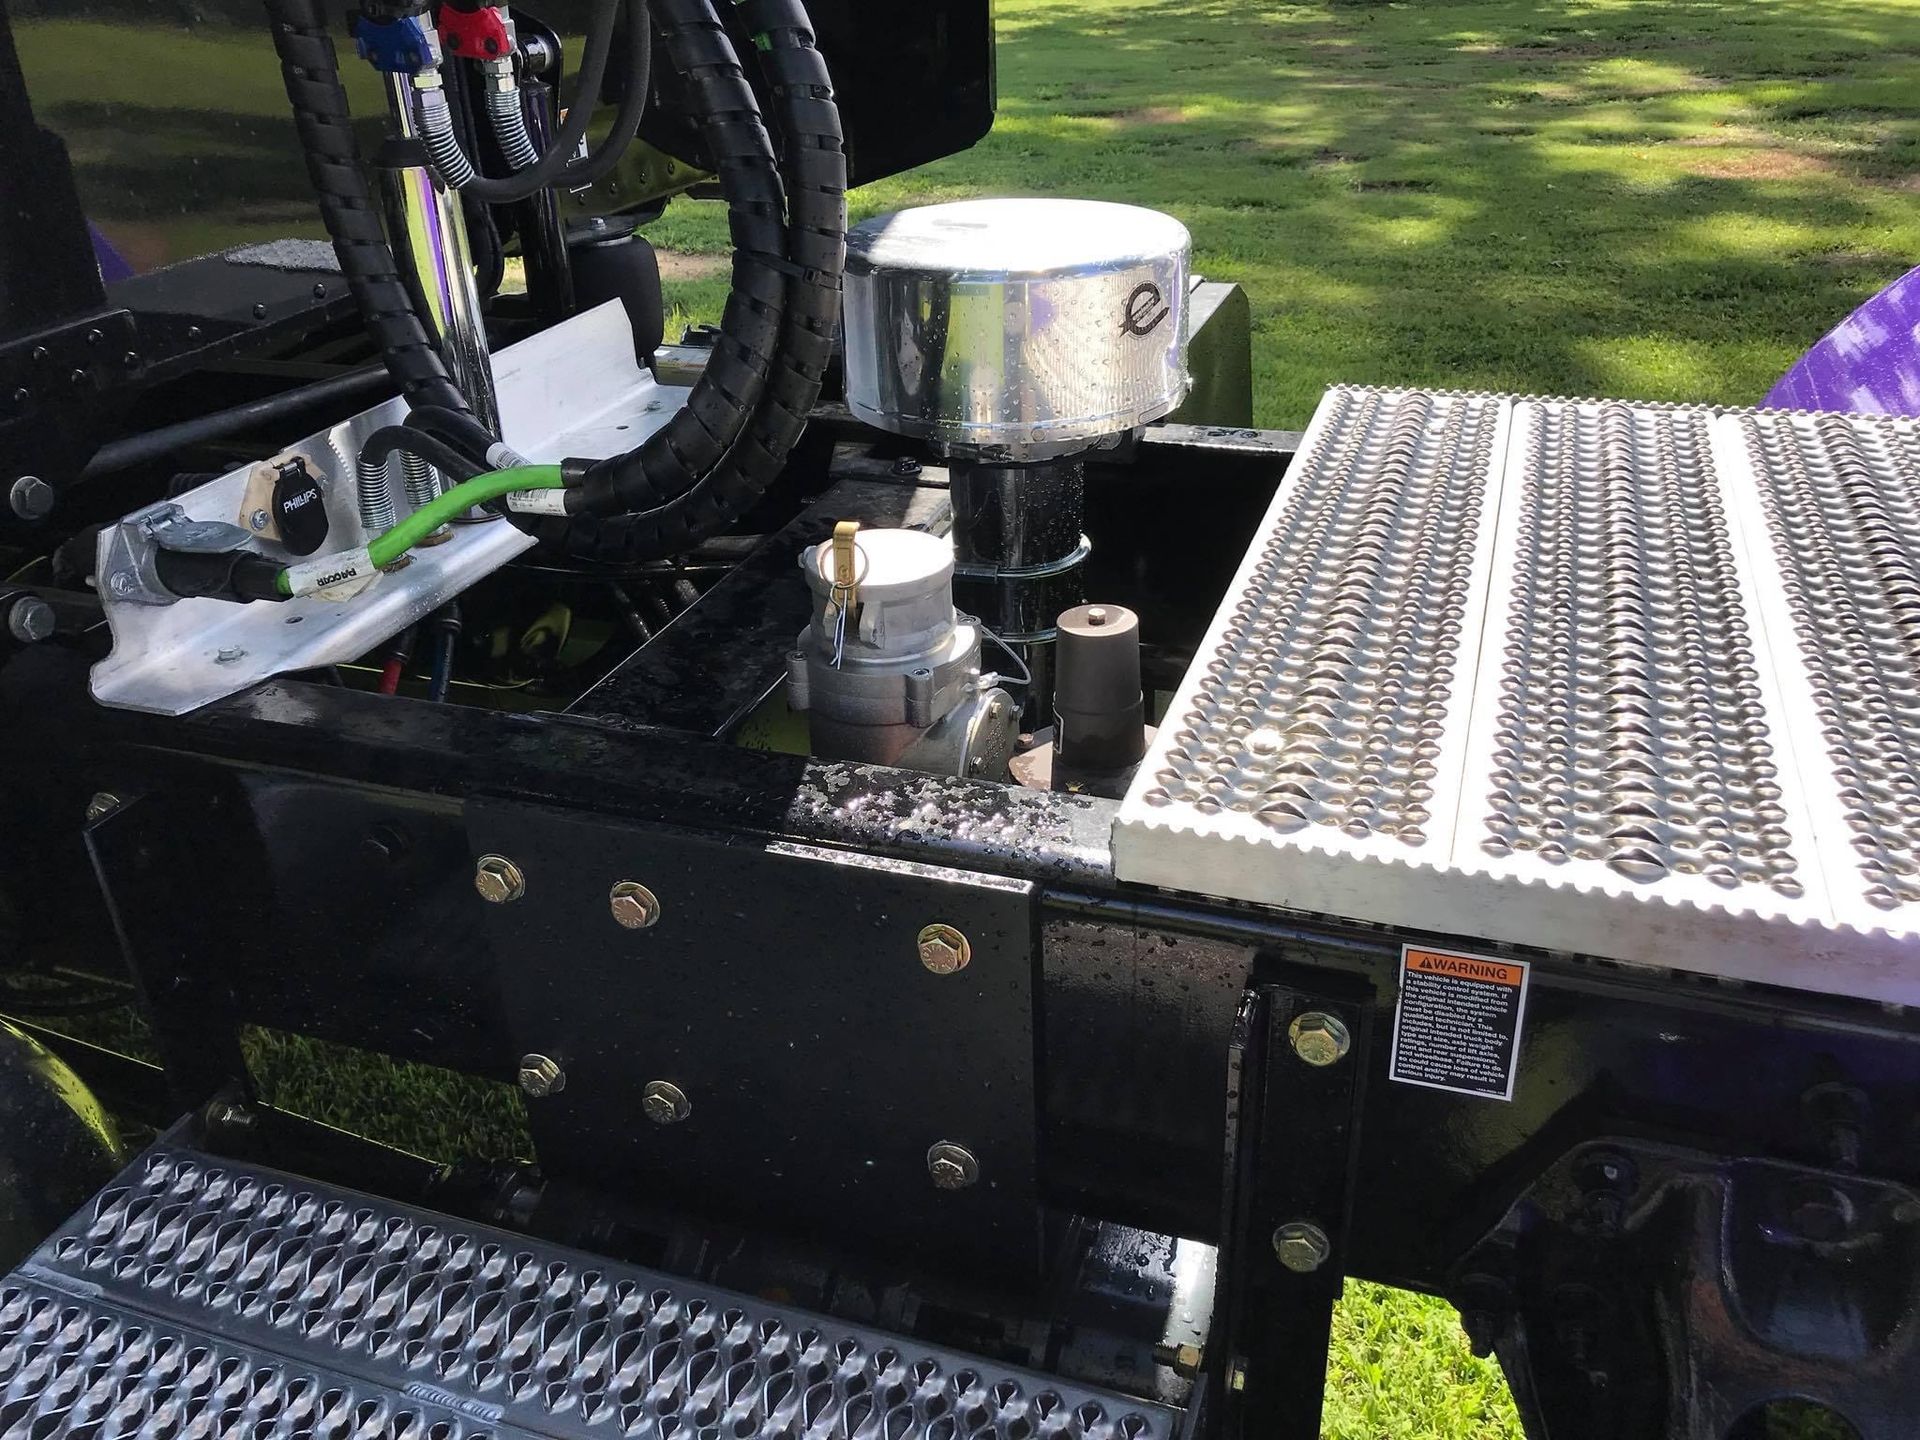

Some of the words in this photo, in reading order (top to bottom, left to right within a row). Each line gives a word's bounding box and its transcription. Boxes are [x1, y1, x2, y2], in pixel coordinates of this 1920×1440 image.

[283, 488, 318, 514] PHILLIPS
[316, 567, 357, 587] PACCAR
[1432, 958, 1507, 979] WARNING
